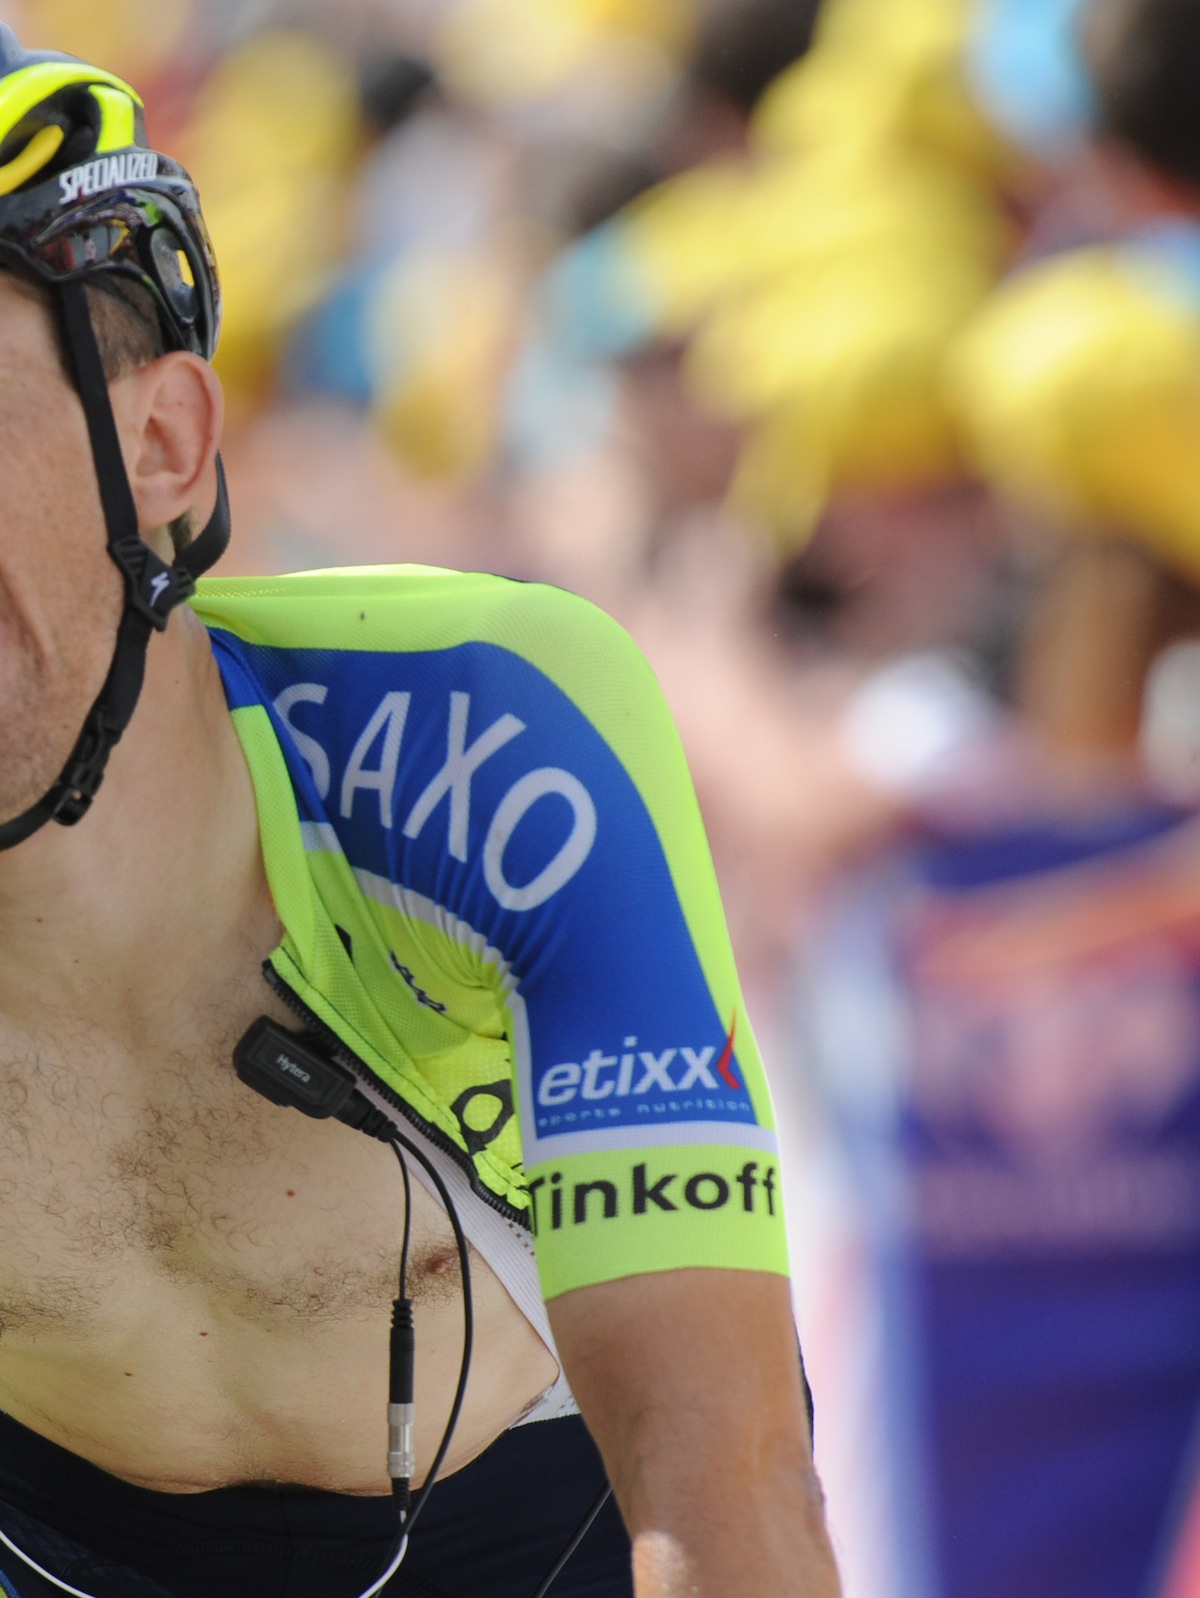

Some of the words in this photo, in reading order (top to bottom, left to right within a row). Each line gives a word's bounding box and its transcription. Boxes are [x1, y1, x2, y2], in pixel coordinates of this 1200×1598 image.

[58, 152, 158, 205] SPECIALIZED
[272, 682, 598, 912] SAXO
[276, 1054, 312, 1083] Hytera
[537, 1035, 720, 1107] etixx
